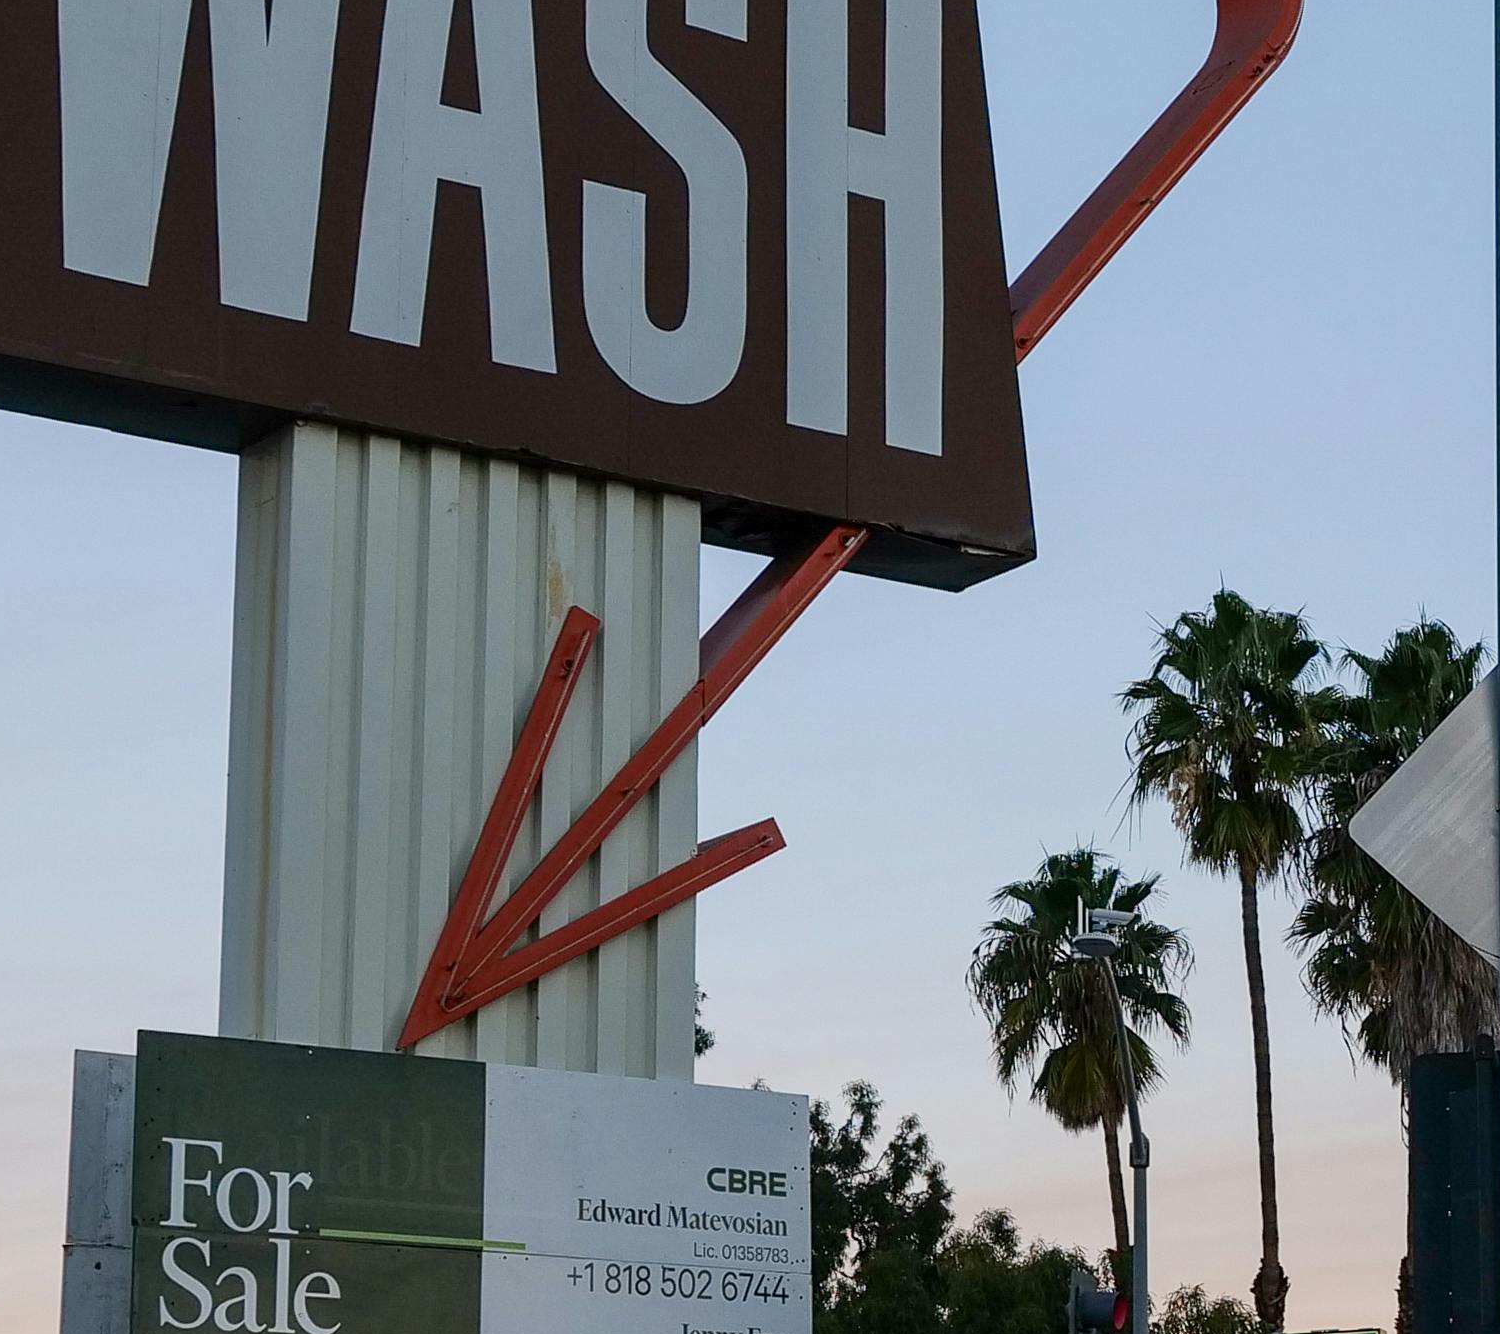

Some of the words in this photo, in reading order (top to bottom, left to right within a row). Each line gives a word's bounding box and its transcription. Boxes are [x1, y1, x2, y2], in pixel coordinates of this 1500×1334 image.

[161, 1136, 313, 1236] For
[706, 1167, 788, 1197] CBRE
[577, 1198, 662, 1227] Edward
[666, 1205, 788, 1237] Matevosian
[693, 1242, 718, 1259] Lic.
[722, 1244, 789, 1264] 01358783
[566, 1263, 595, 1292] +1
[605, 1263, 652, 1296] 818
[660, 1266, 713, 1300] 502
[721, 1271, 790, 1304] 6744
